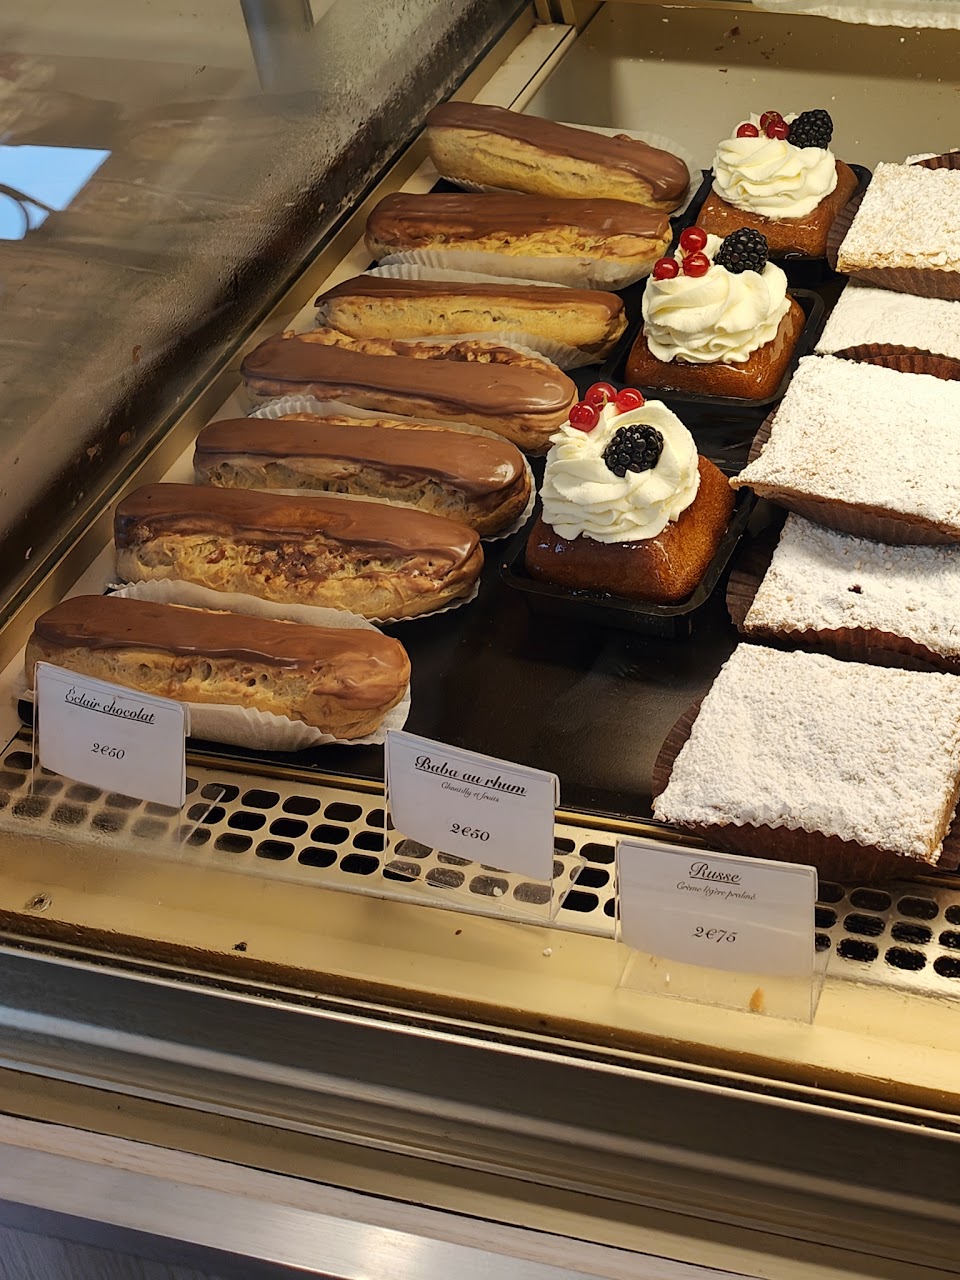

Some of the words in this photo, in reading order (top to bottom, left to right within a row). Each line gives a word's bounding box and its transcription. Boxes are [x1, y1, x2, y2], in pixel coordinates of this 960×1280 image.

[64, 686, 100, 710] Éclair
[103, 697, 156, 724] chocolat
[90, 742, 126, 760] 2€50
[414, 755, 459, 778] Baba
[462, 771, 483, 786] au
[484, 776, 527, 797] rhum
[441, 781, 472, 798] Chantilly
[449, 822, 491, 842] 2€50
[688, 861, 742, 885] Russe
[676, 880, 702, 893] Crème
[692, 926, 738, 943] 2€75
